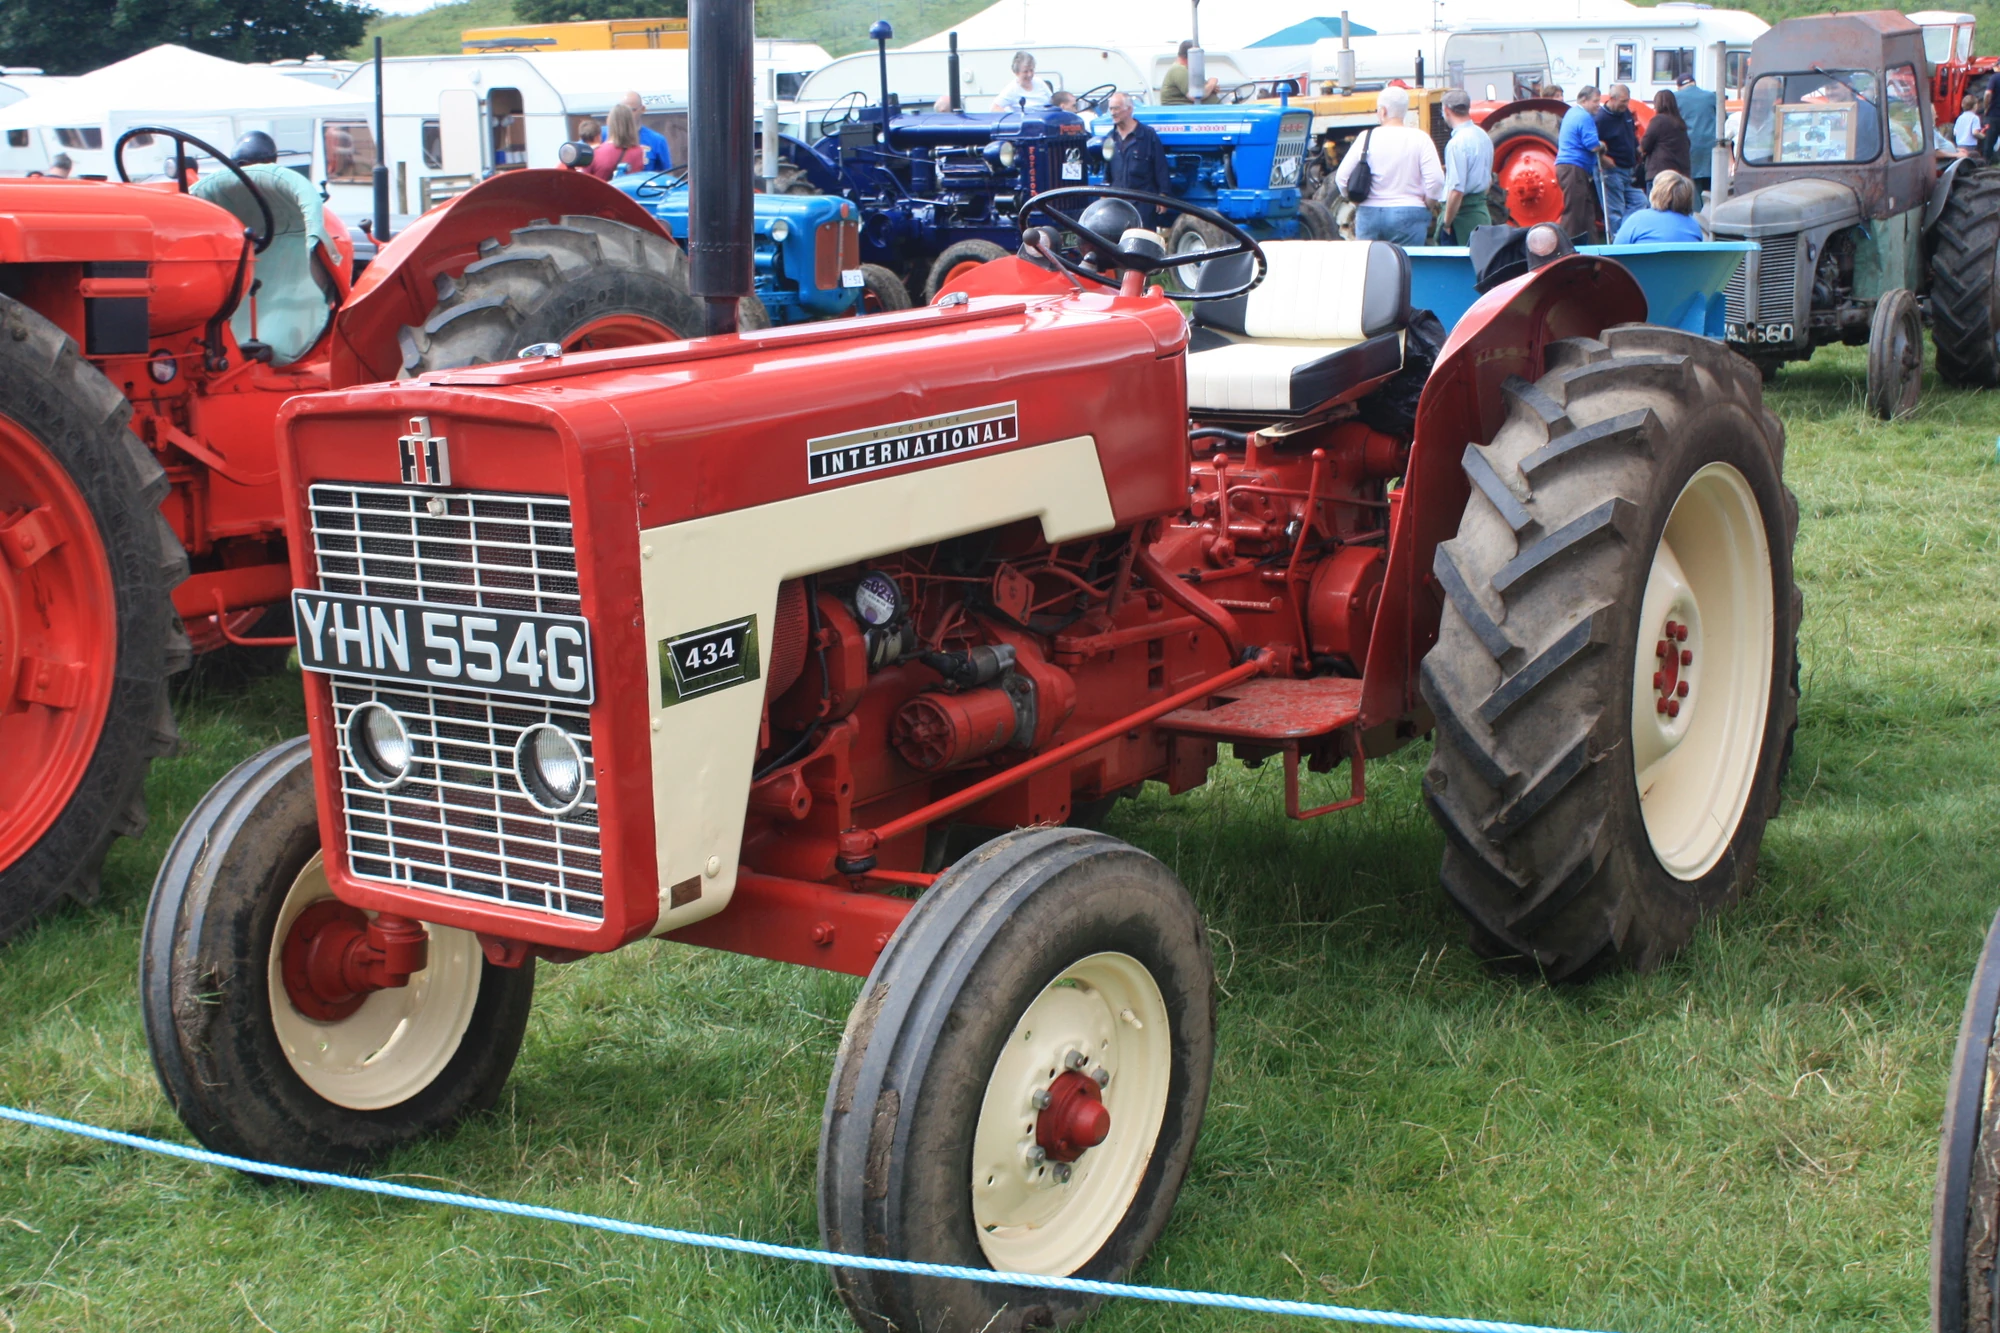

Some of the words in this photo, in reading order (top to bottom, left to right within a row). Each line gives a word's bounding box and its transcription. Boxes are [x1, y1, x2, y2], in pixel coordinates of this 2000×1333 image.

[641, 94, 675, 105] SPRITE
[821, 421, 1007, 475] INTERNATIONAL
[298, 599, 410, 672] YHN
[422, 612, 585, 692] 554G
[685, 637, 735, 669] 434
